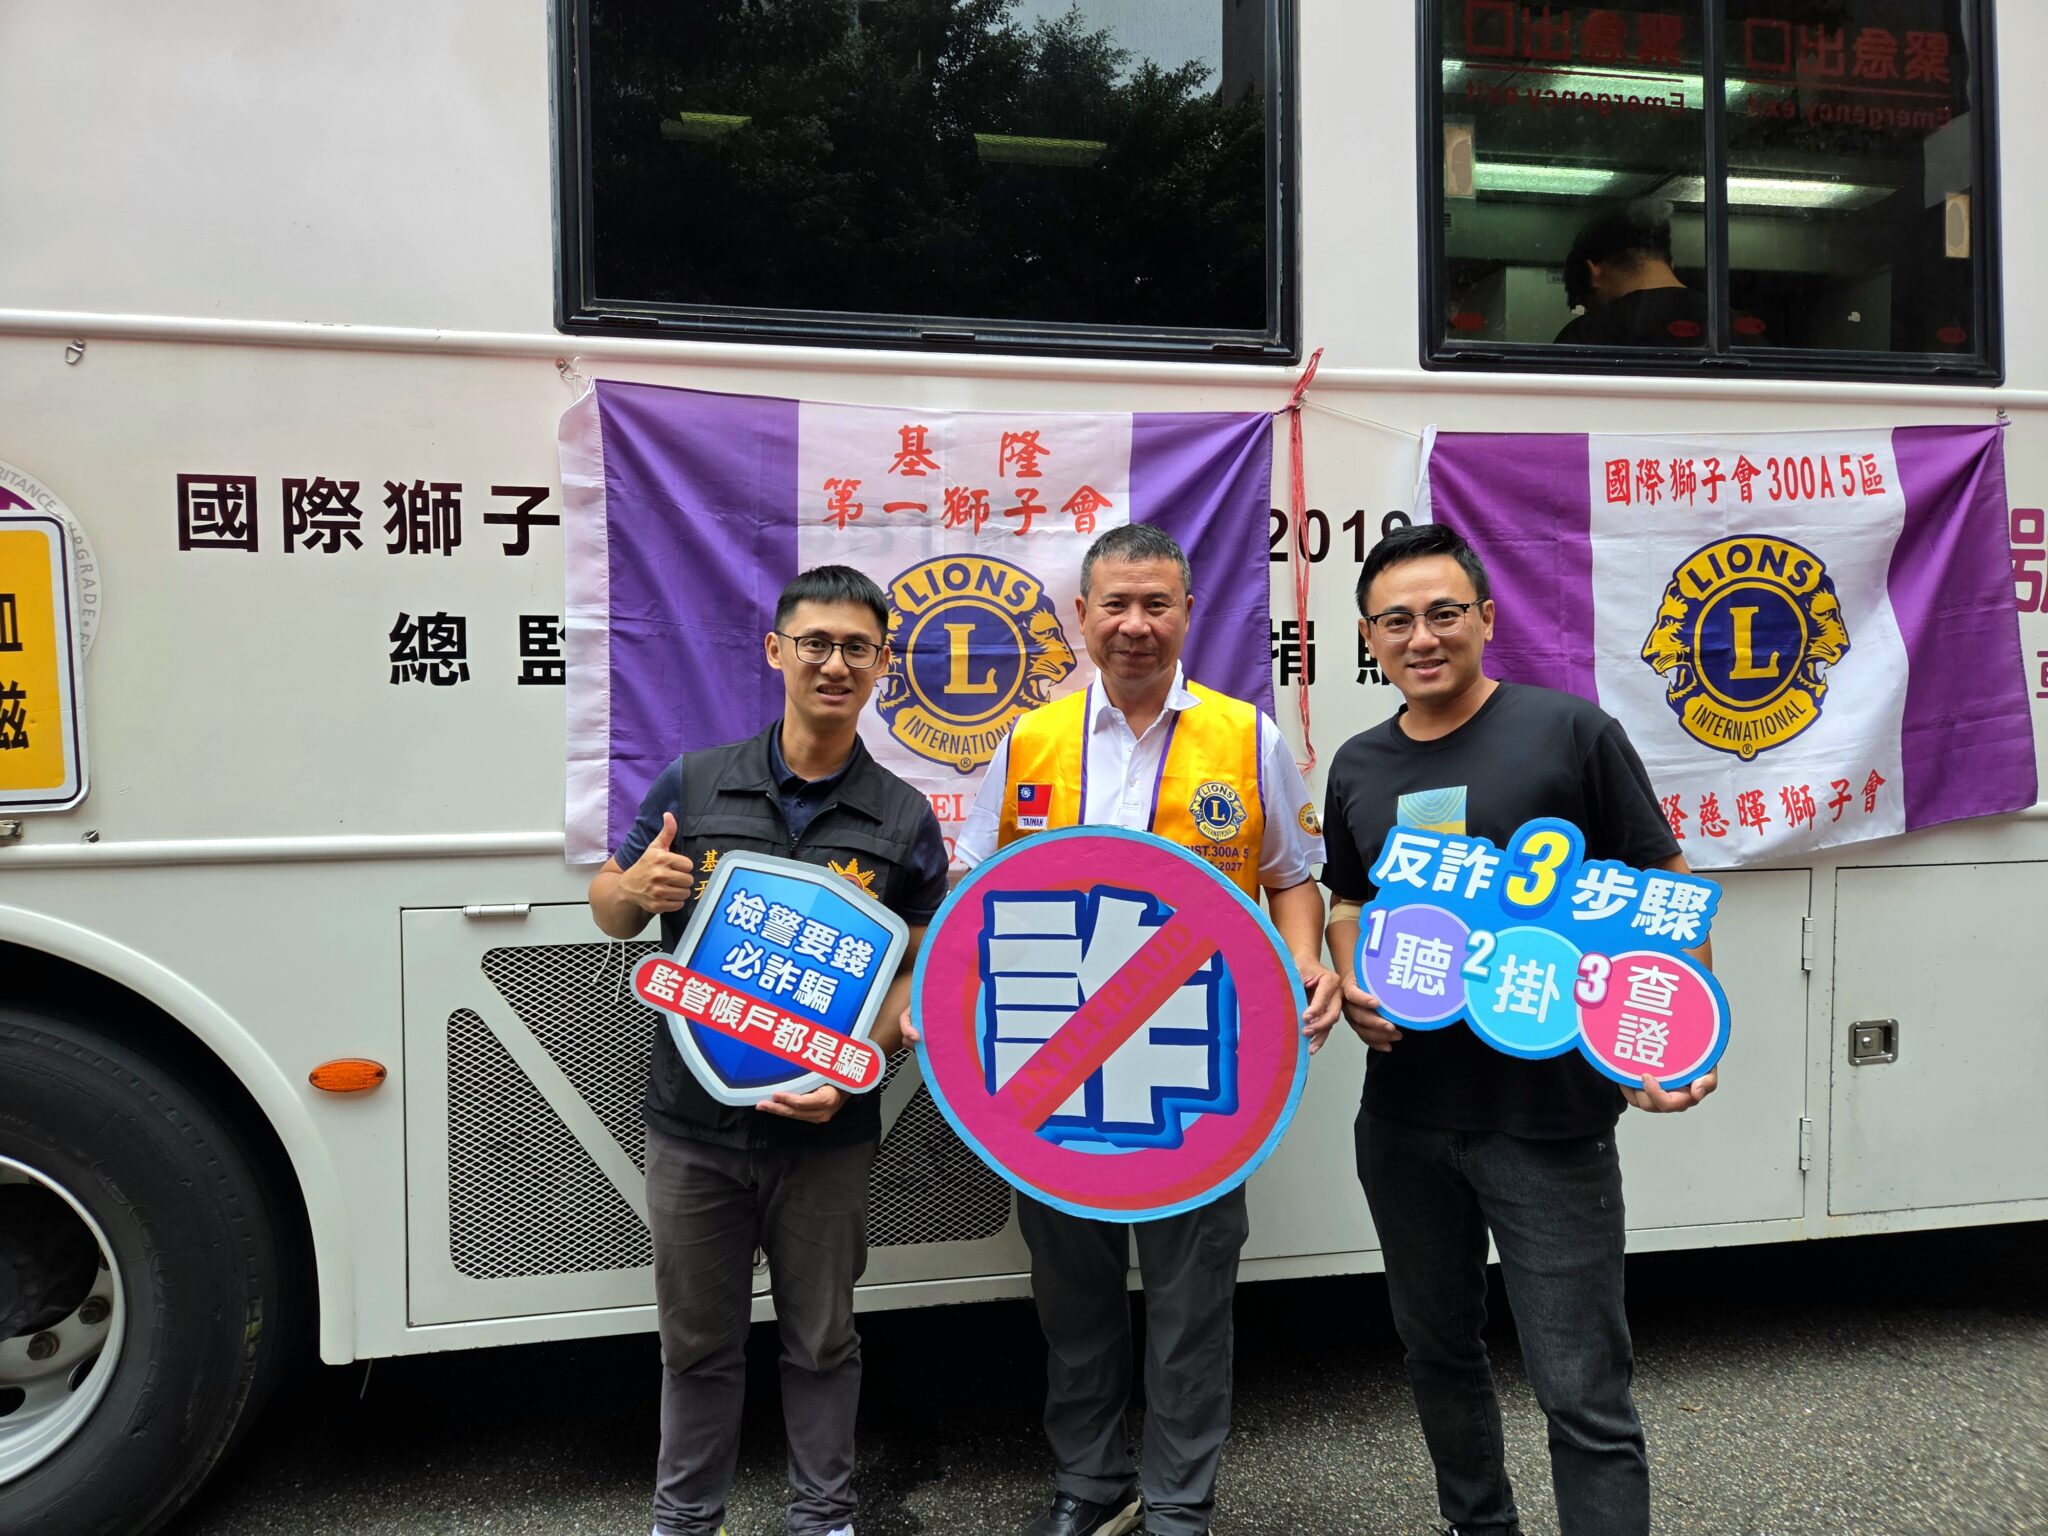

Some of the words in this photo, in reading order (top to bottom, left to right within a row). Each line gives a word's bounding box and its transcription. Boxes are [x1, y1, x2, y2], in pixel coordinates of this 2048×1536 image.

[887, 424, 1051, 478] 基隆
[176, 473, 561, 557] 國際獅子
[822, 477, 1113, 537] 第一獅子會
[901, 562, 1032, 608] LIONS
[1686, 543, 1814, 593] LIONS
[943, 622, 999, 694] L
[1729, 606, 1781, 680] L
[902, 714, 1017, 755] INTERNATION
[1691, 699, 1808, 742] INTERNATIONAL
[1201, 784, 1235, 799] LIONS
[1210, 800, 1226, 821] L
[1659, 768, 1887, 840] 隆慈暉獅子會
[1022, 817, 1044, 827] TAIWAN
[726, 888, 875, 979] 檢警要錢
[1366, 909, 1388, 951] 1
[1461, 930, 1496, 977] 2
[721, 941, 839, 1015] 必詐騙
[1385, 931, 1454, 997] 聽
[1492, 953, 1561, 1024] 掛
[1576, 954, 1610, 1003] 3
[643, 964, 873, 1084] 監管帳戶都是騙
[1010, 921, 1195, 1109] ANTI-FRAUD
